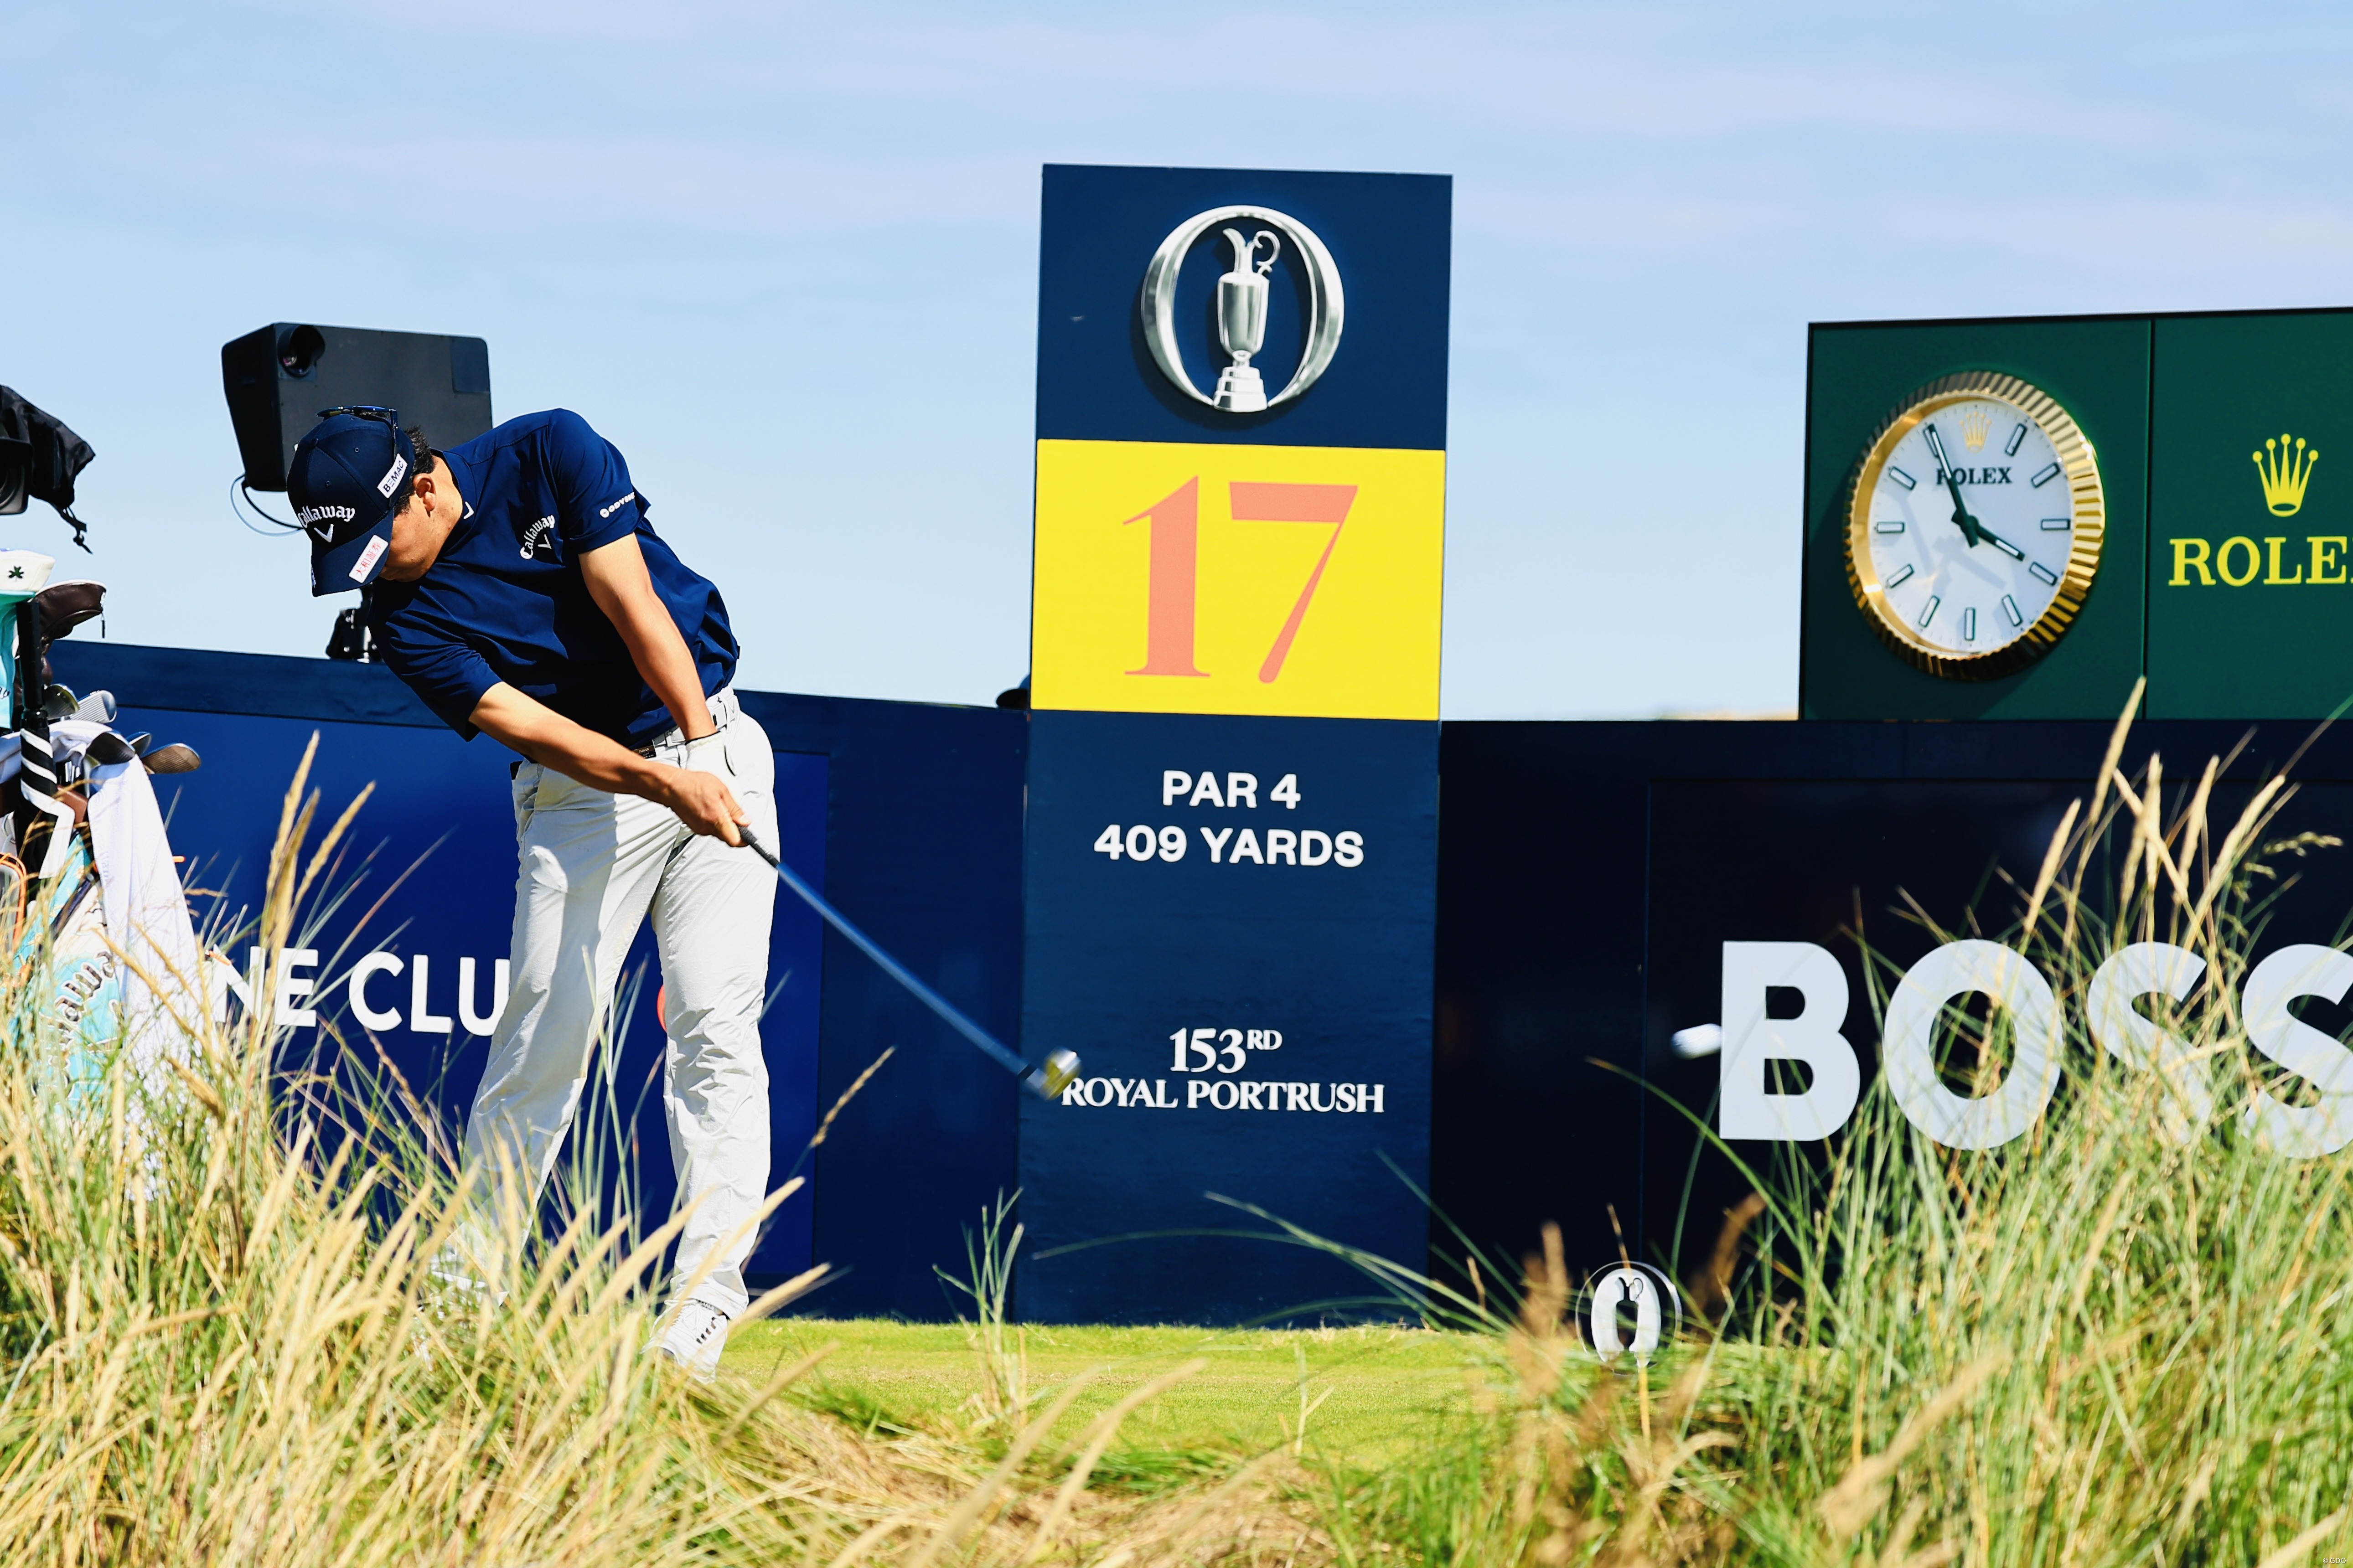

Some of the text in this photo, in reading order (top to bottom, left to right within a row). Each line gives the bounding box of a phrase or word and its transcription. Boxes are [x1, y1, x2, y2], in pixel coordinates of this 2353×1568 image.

[297, 505, 356, 528] Callaway
[520, 515, 555, 559] Callaway
[1123, 475, 1359, 684] 17
[2168, 536, 2353, 587] ROLE
[1162, 770, 1301, 809] PAR 4
[1094, 824, 1365, 867] 409 YARDS
[1169, 1027, 1283, 1073] 153RD
[1719, 939, 2353, 1159] BOSS
[1061, 1078, 1385, 1113] ROYAL PORTRUSH
